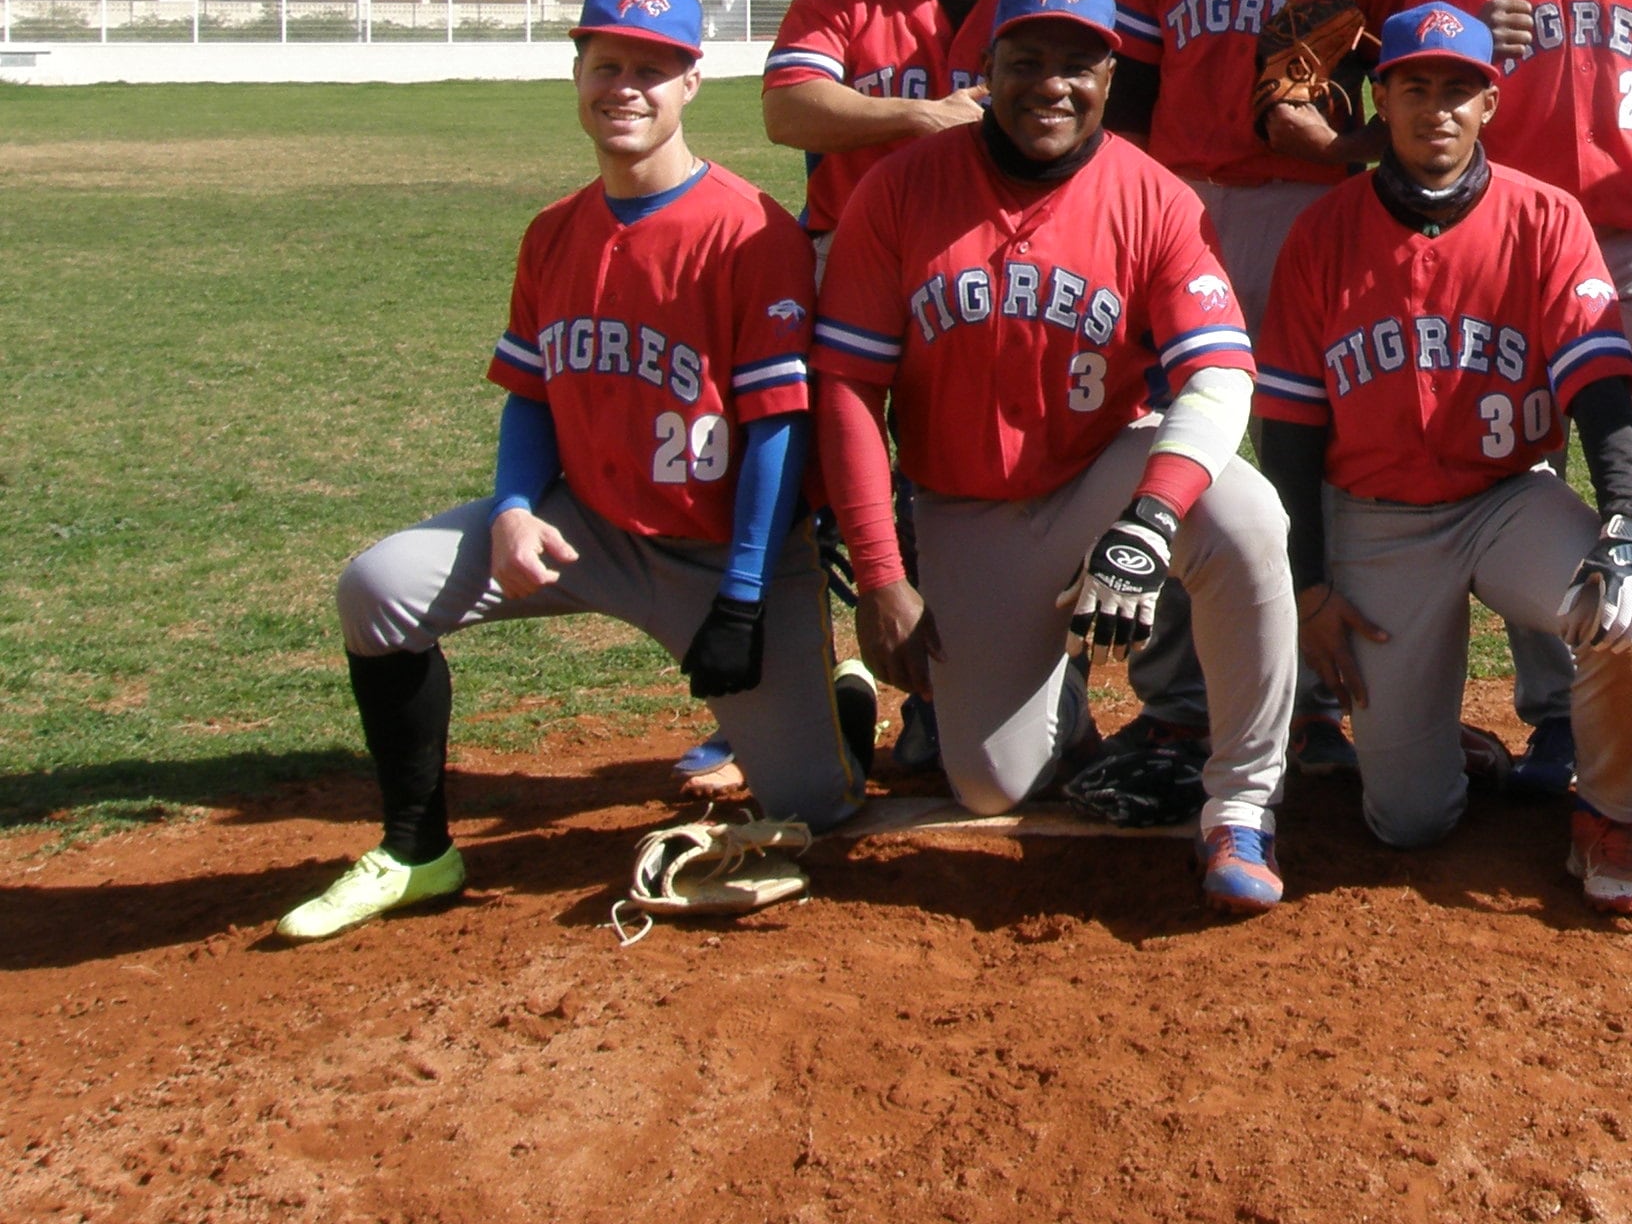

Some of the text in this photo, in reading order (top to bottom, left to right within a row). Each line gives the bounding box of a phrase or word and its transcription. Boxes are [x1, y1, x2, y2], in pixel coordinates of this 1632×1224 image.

[909, 261, 1122, 347] TIGRES
[536, 317, 703, 404] TIGRES
[1068, 350, 1108, 413] 3
[1323, 314, 1528, 398] TIGRES
[650, 411, 731, 485] 29
[1477, 388, 1552, 460] 30
